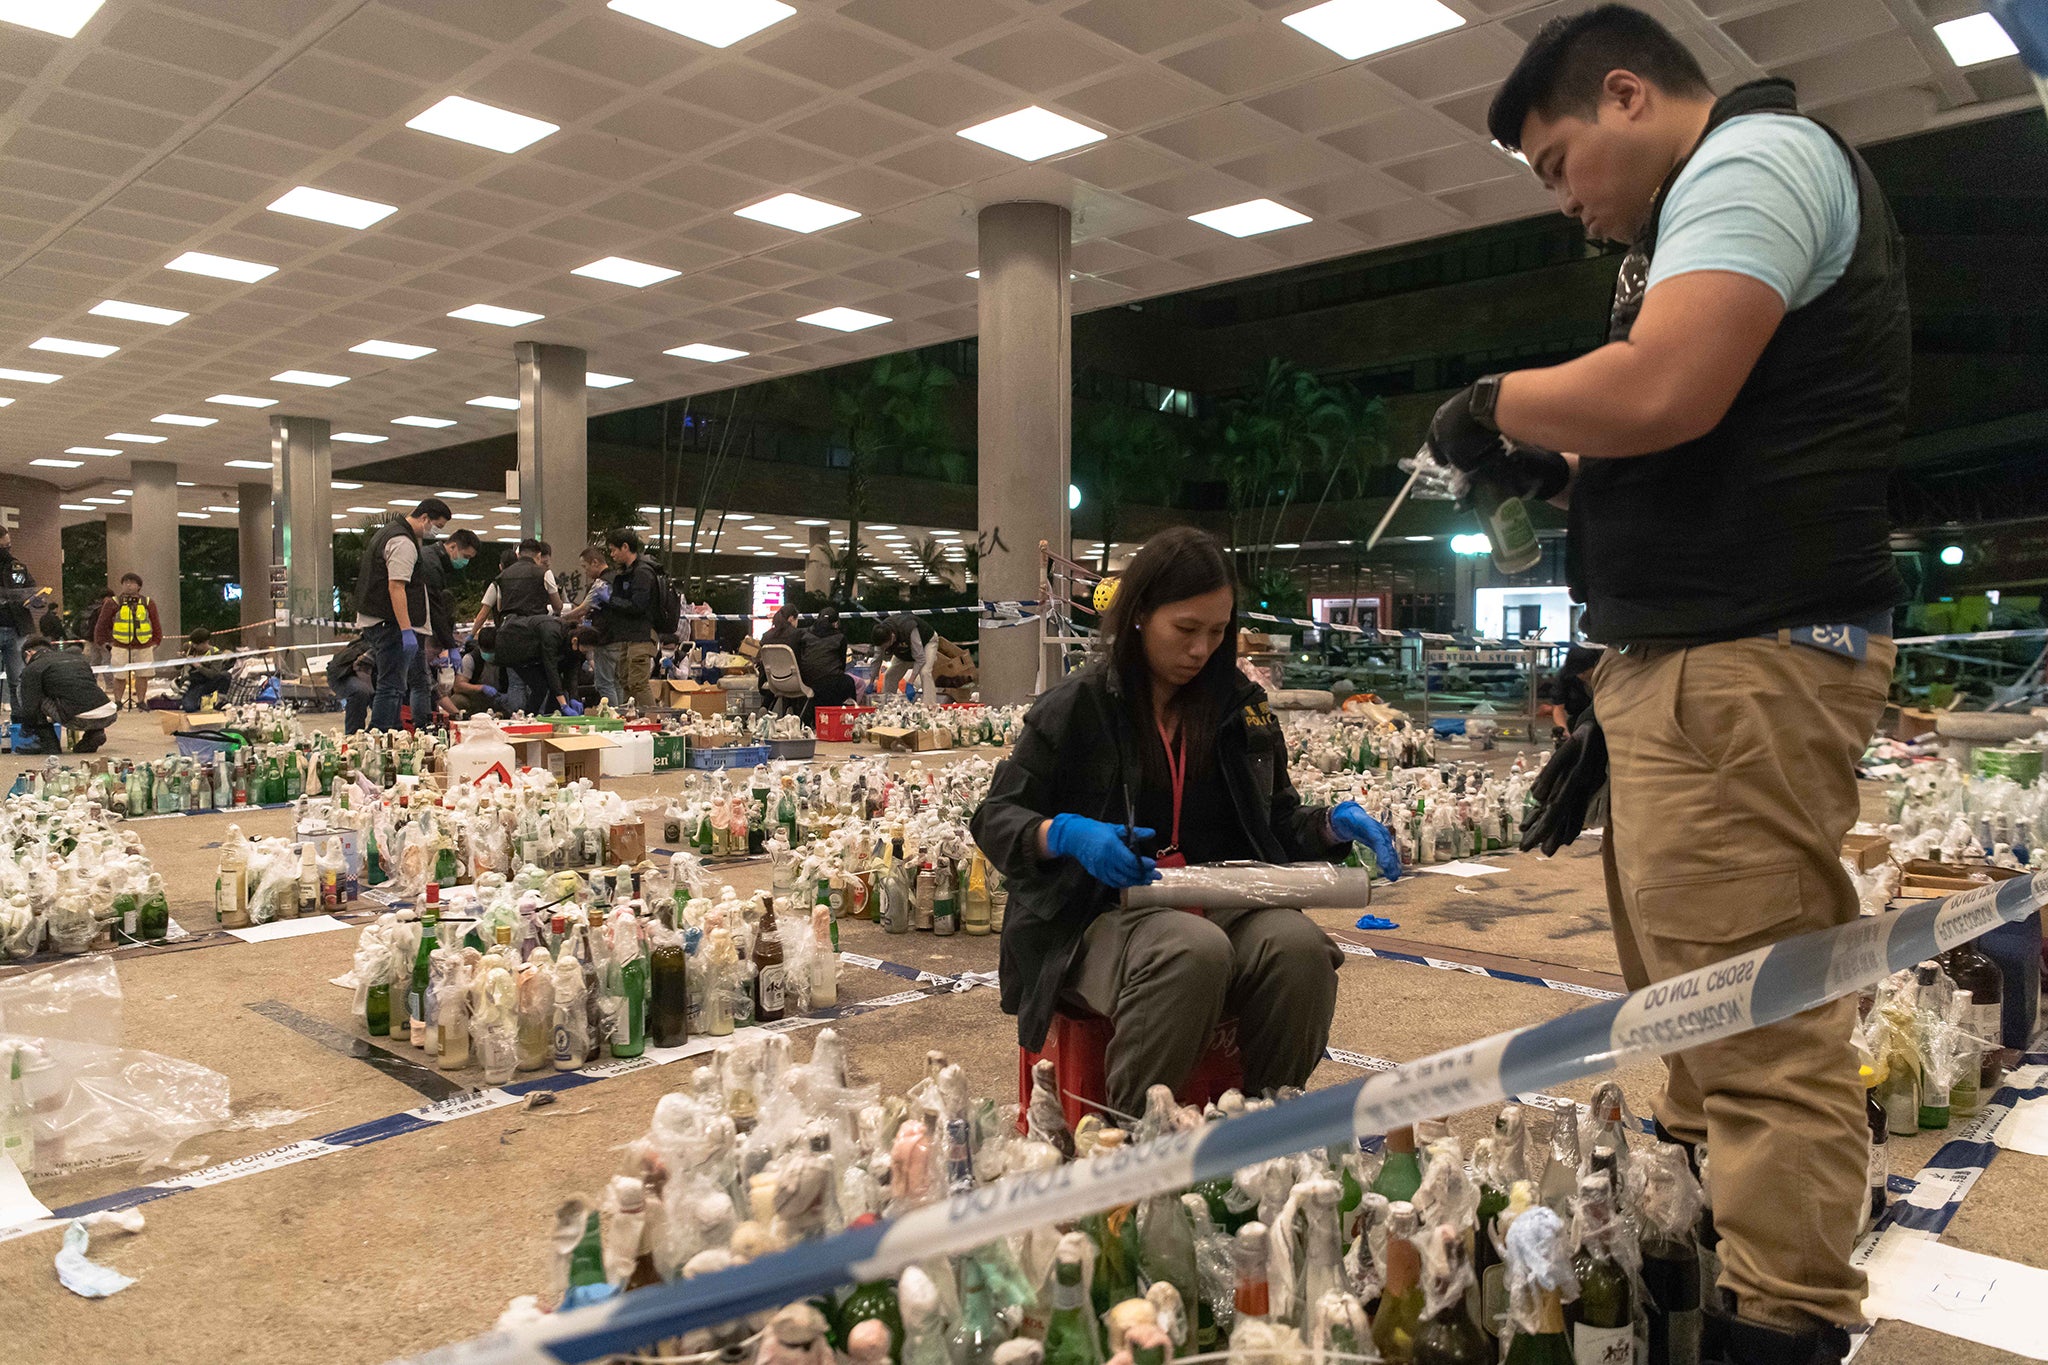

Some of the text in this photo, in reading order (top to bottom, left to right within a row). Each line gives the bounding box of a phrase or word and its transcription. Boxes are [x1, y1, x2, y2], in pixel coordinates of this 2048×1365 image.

[1430, 653, 1480, 661] CENTRAL
[1245, 714, 1272, 726] POLIC
[581, 1061, 622, 1073] POLICE
[274, 1145, 329, 1163] CROSS
[164, 1162, 226, 1184] POLICE
[230, 1143, 300, 1168] CORDON
